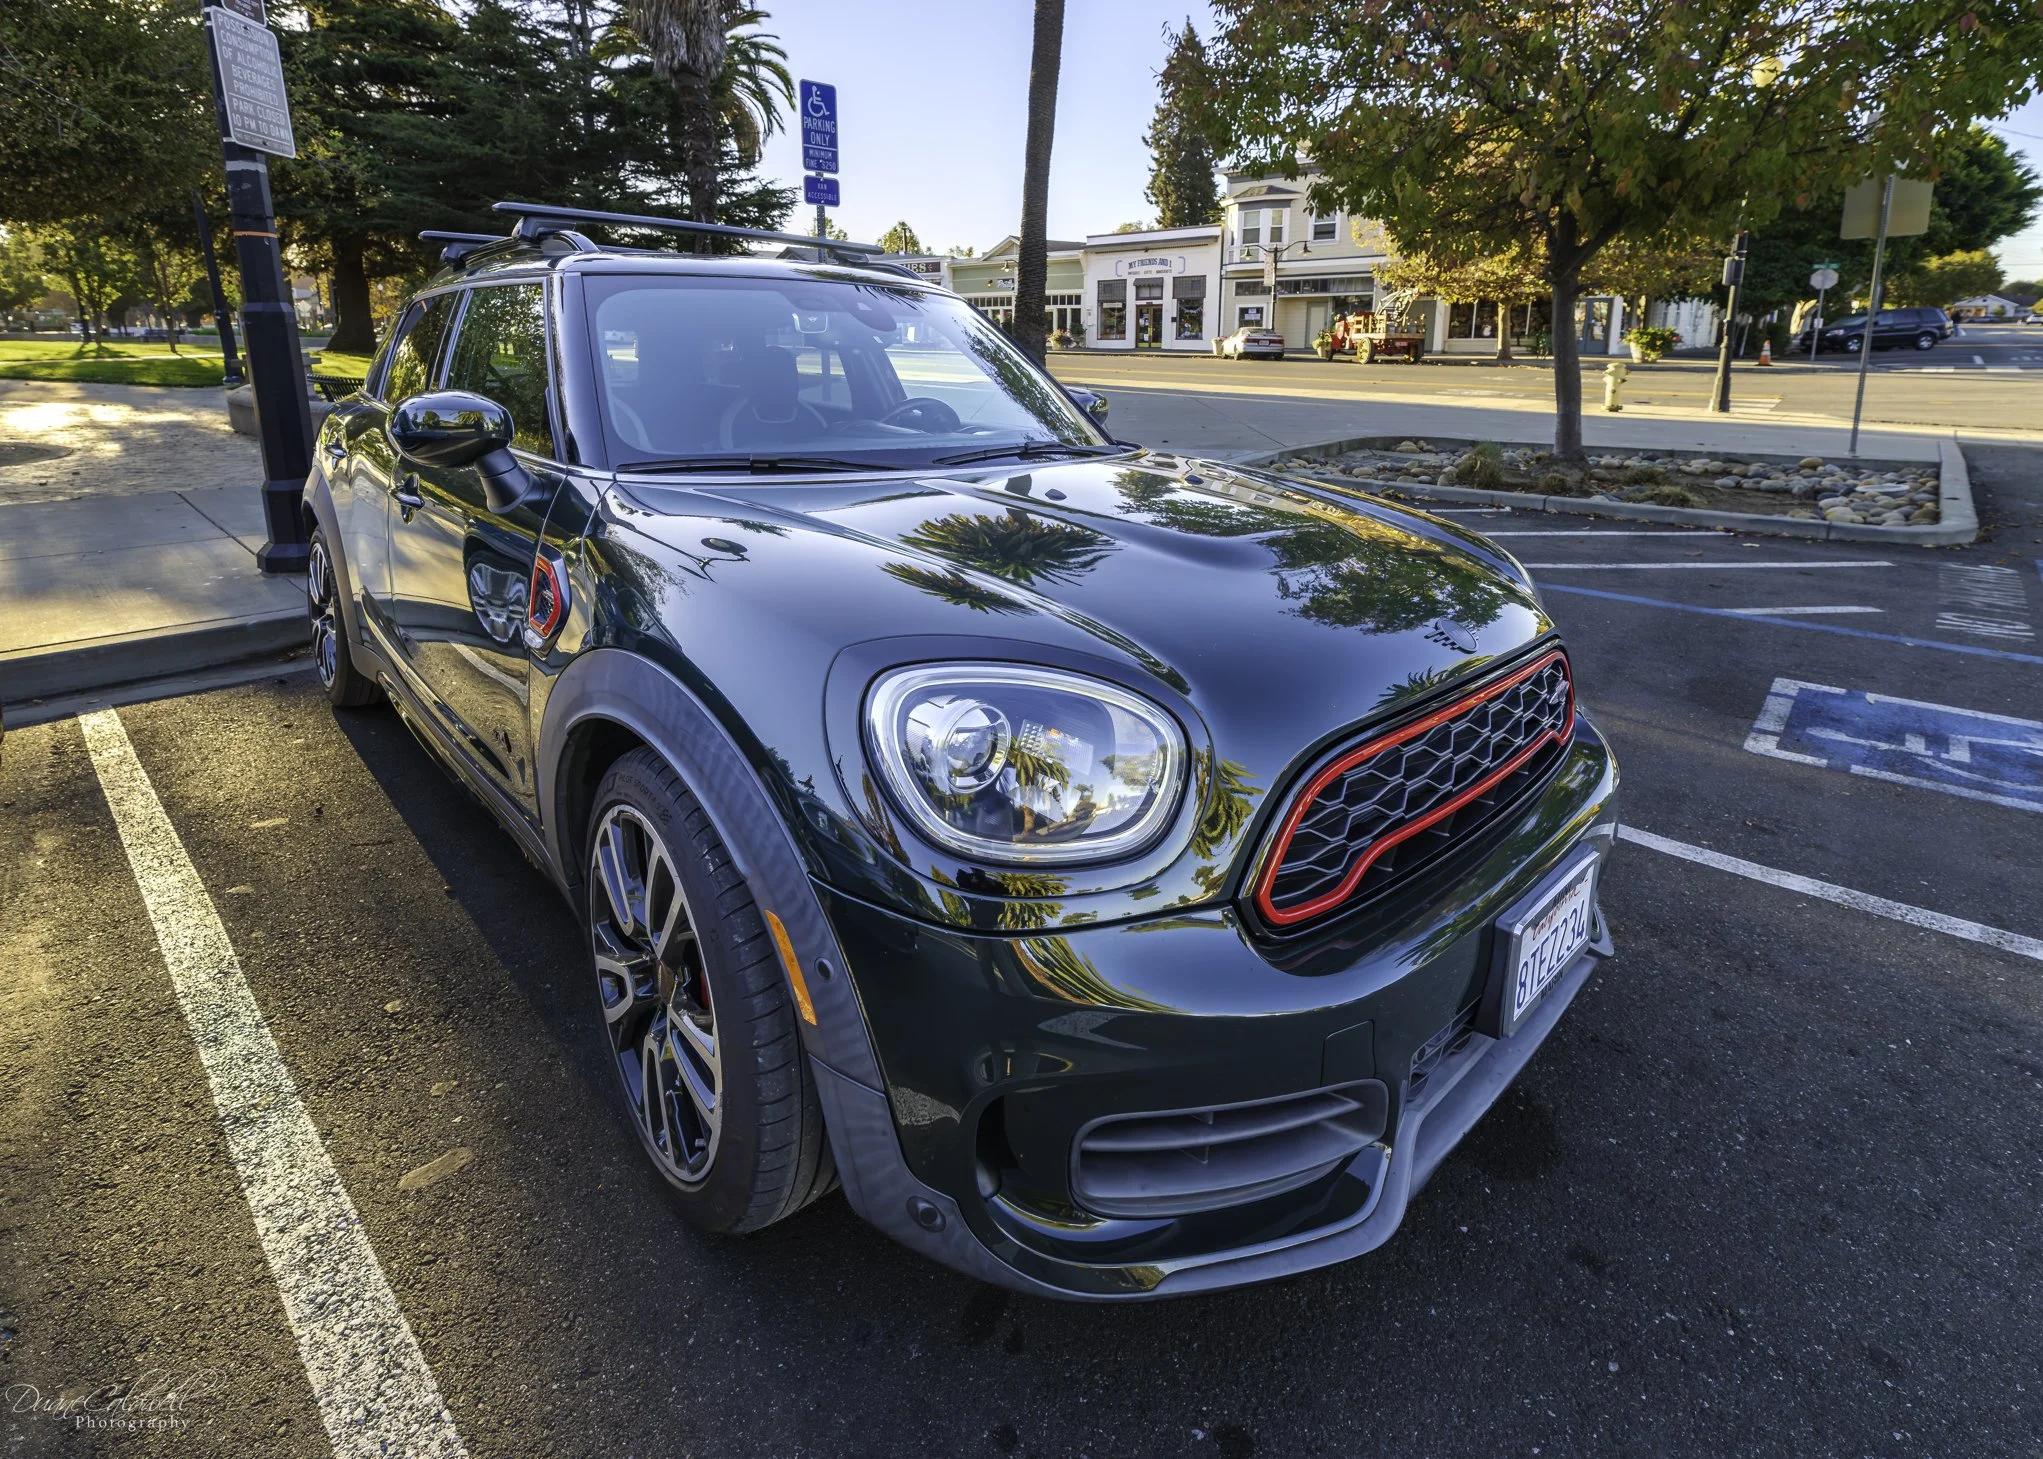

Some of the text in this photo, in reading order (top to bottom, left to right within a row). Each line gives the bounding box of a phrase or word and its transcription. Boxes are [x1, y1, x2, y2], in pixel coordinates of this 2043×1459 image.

[220, 30, 276, 63] CONSUMPTION
[222, 46, 279, 78] OF ALCOHOLIC
[231, 64, 276, 91] BEVERAGES
[233, 79, 278, 106] PROHIBITED
[232, 98, 285, 126] PARK CLOSED
[803, 116, 836, 134] PARKING
[231, 112, 291, 142] 10 PM TO DAWN
[810, 131, 830, 146] ONLY
[805, 158, 818, 168] FINE
[809, 148, 832, 160] MINIMUM
[808, 191, 837, 201] ACCESSIBLE
[1128, 260, 1137, 270] MY
[1137, 258, 1158, 267] FRIENDS
[1158, 257, 1169, 267] AND
[1935, 611, 2036, 642] NO
[1516, 899, 1586, 1010] 8TEZ234
